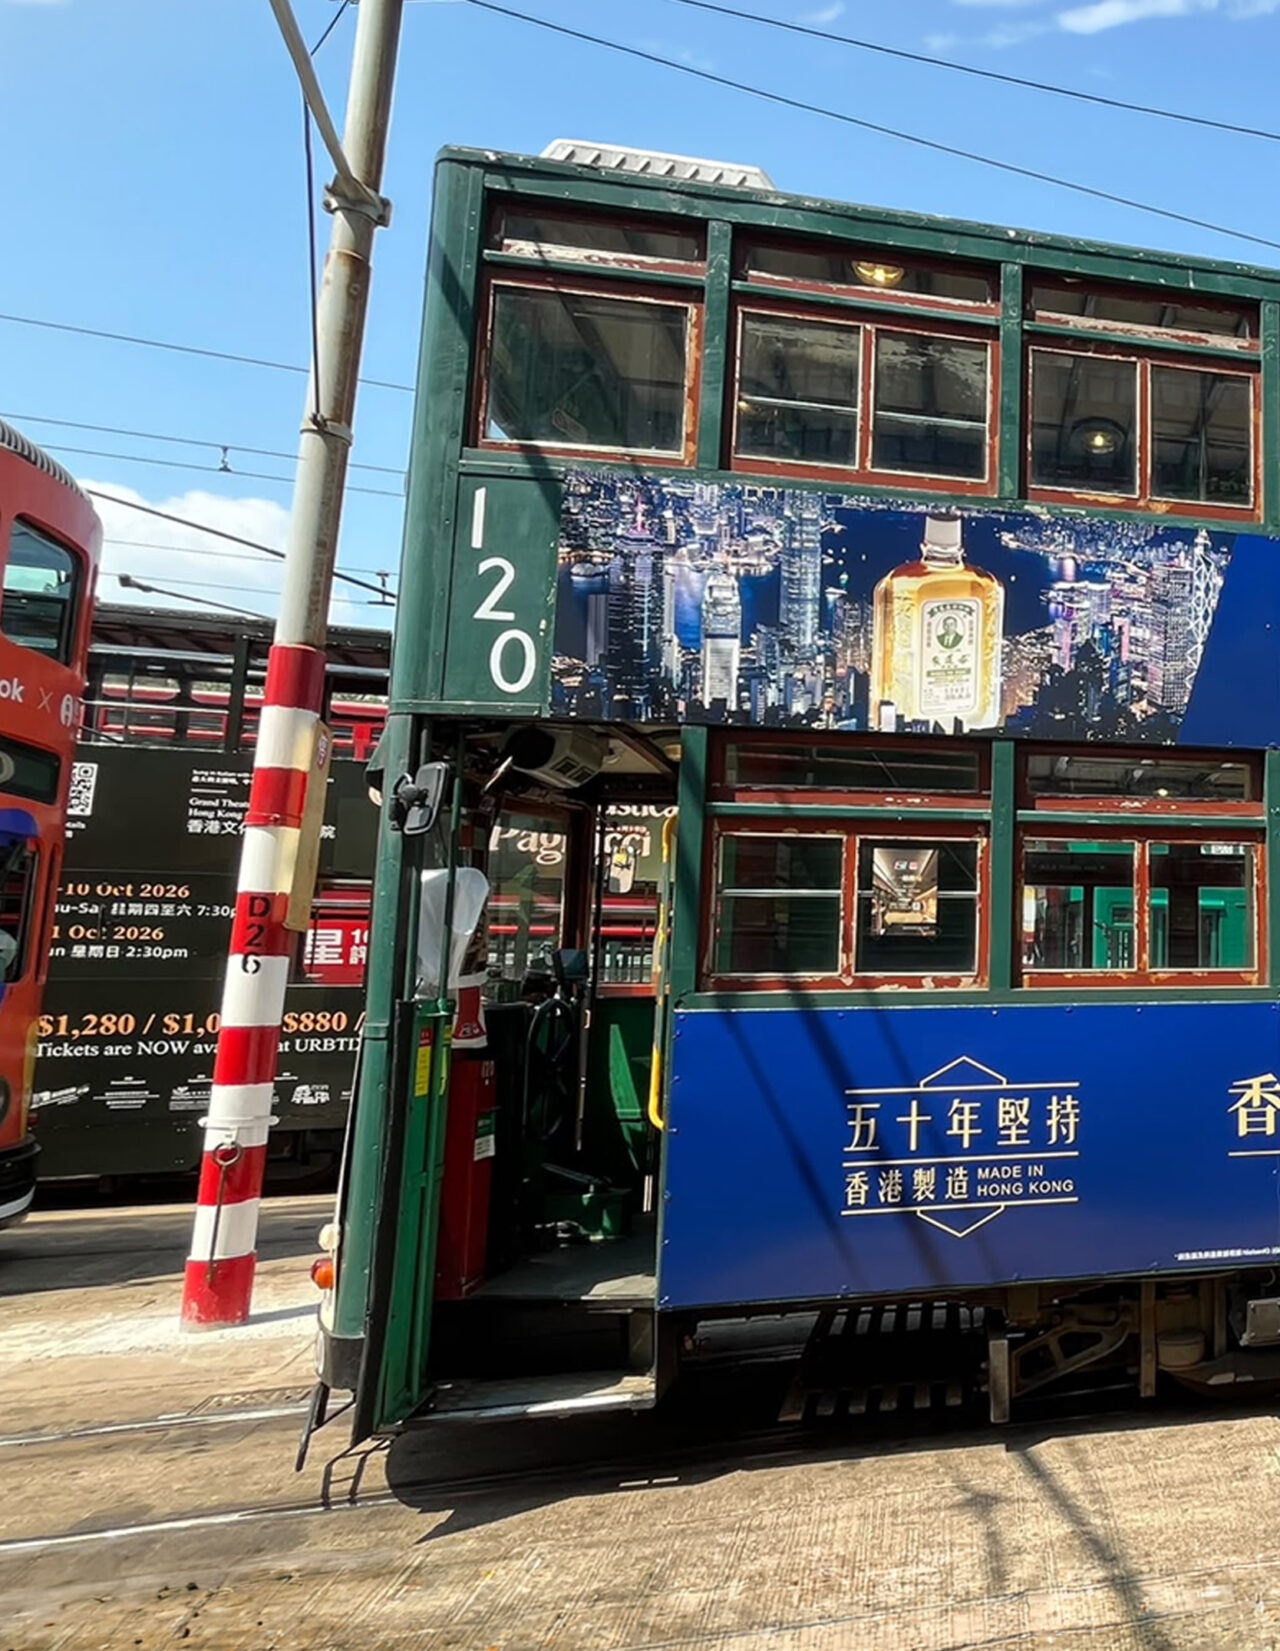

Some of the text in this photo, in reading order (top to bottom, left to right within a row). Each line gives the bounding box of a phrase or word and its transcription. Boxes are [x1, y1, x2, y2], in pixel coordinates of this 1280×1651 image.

[0, 677, 24, 703] ok
[96, 883, 134, 897] Oct
[140, 884, 190, 898] 2026
[113, 926, 164, 940] 2026
[126, 946, 188, 959] 2:30pm
[36, 1013, 136, 1040] $1,280
[162, 1013, 221, 1038] $1,0
[282, 1011, 348, 1033] $880
[36, 1042, 99, 1058] Tickets
[103, 1047, 133, 1056] are
[137, 1040, 190, 1056] NOW
[843, 1094, 1080, 1152] 五十年堅持
[844, 1164, 1044, 1207] 香港製造 MADE IN
[977, 1179, 1074, 1197] HONG KONG
